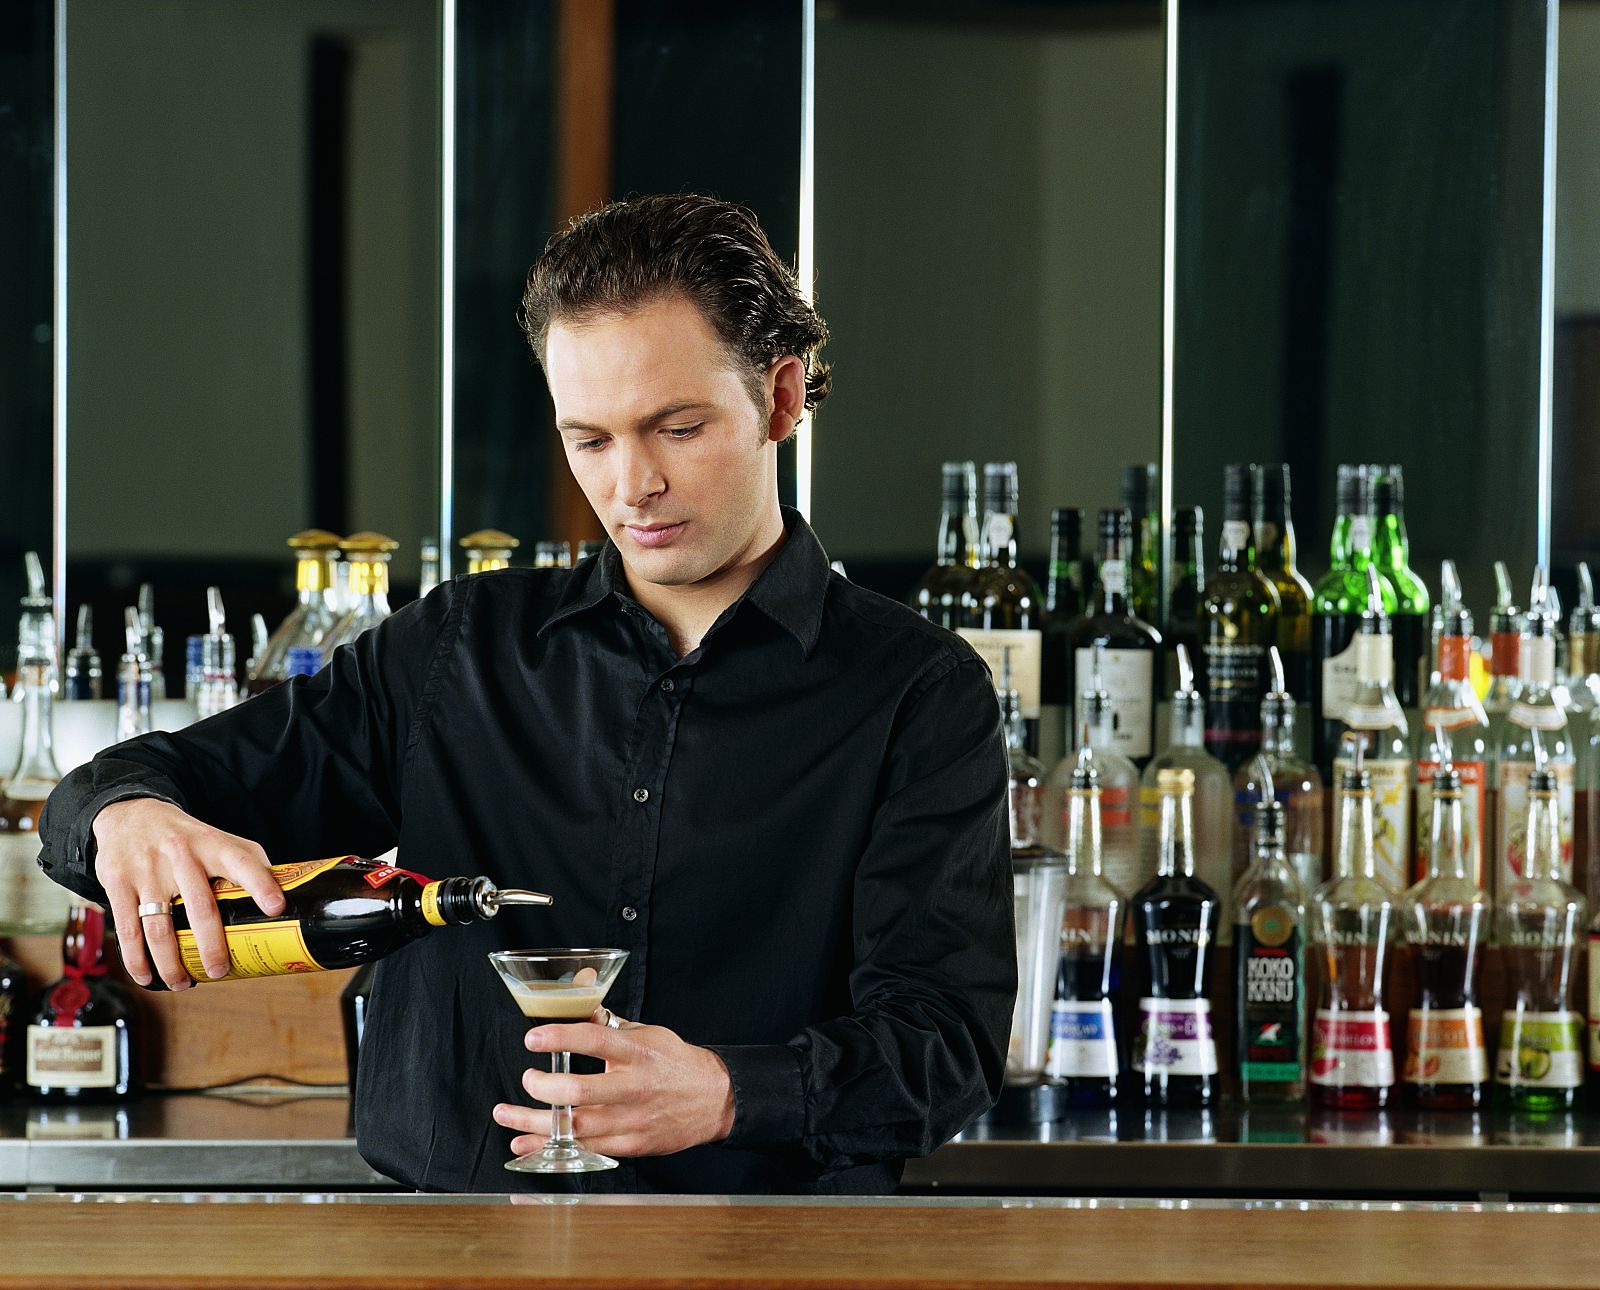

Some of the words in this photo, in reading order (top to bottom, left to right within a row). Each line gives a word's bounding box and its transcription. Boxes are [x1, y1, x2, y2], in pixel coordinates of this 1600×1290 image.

[1060, 928, 1092, 943] NIN
[1146, 928, 1212, 945] MONIN
[1247, 957, 1295, 980] KOKO
[1247, 979, 1295, 1002] KANU
